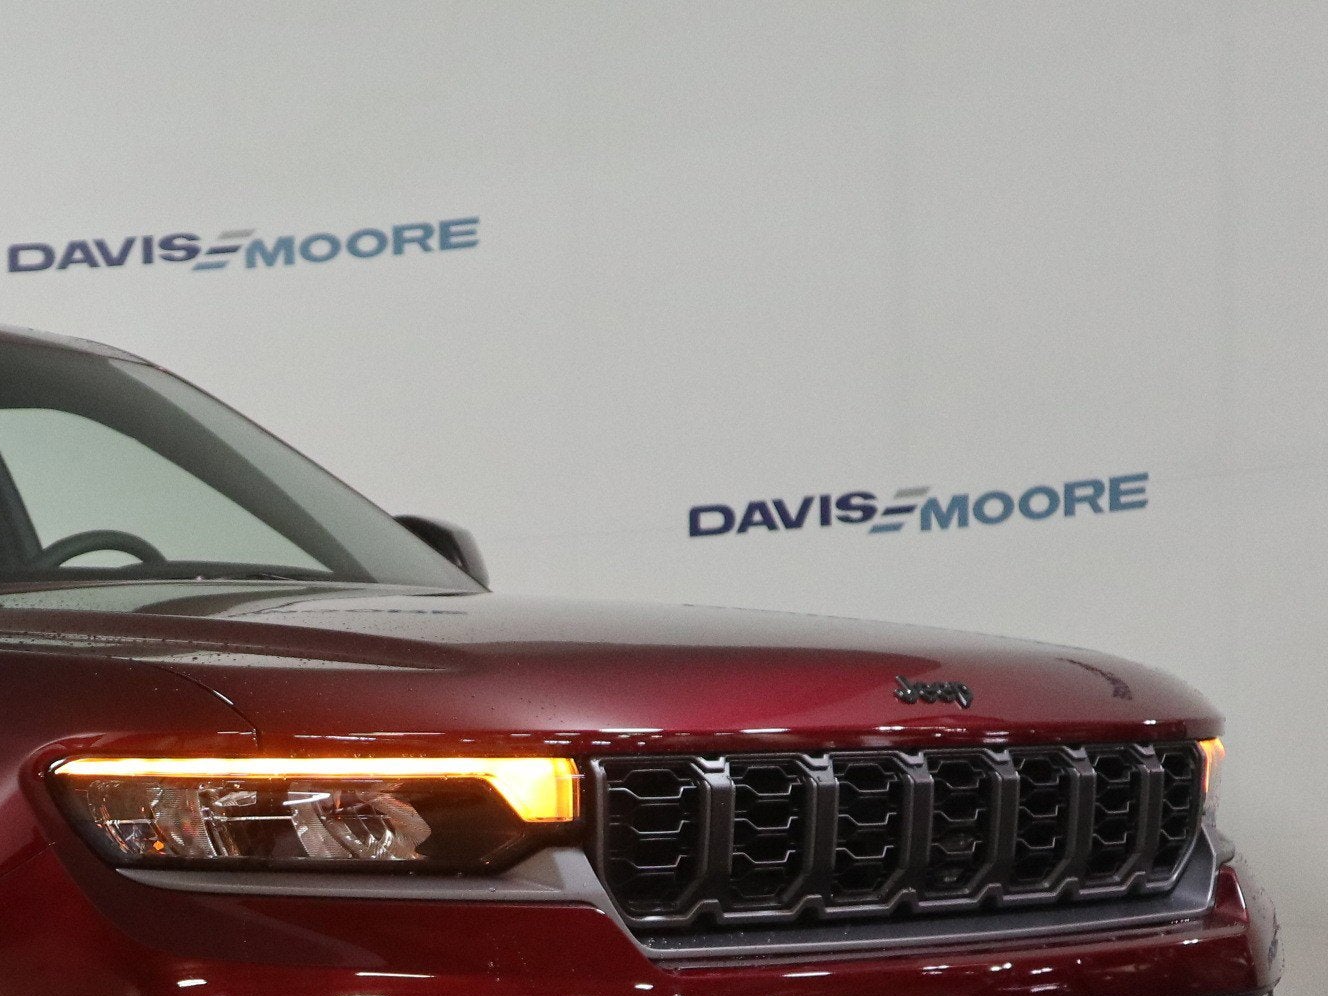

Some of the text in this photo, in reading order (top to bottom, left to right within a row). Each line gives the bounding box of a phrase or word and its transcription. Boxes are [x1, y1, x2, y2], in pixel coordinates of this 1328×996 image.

[6, 217, 480, 274] DAVIS MOORE
[687, 472, 1149, 538] DAVIS MOORE
